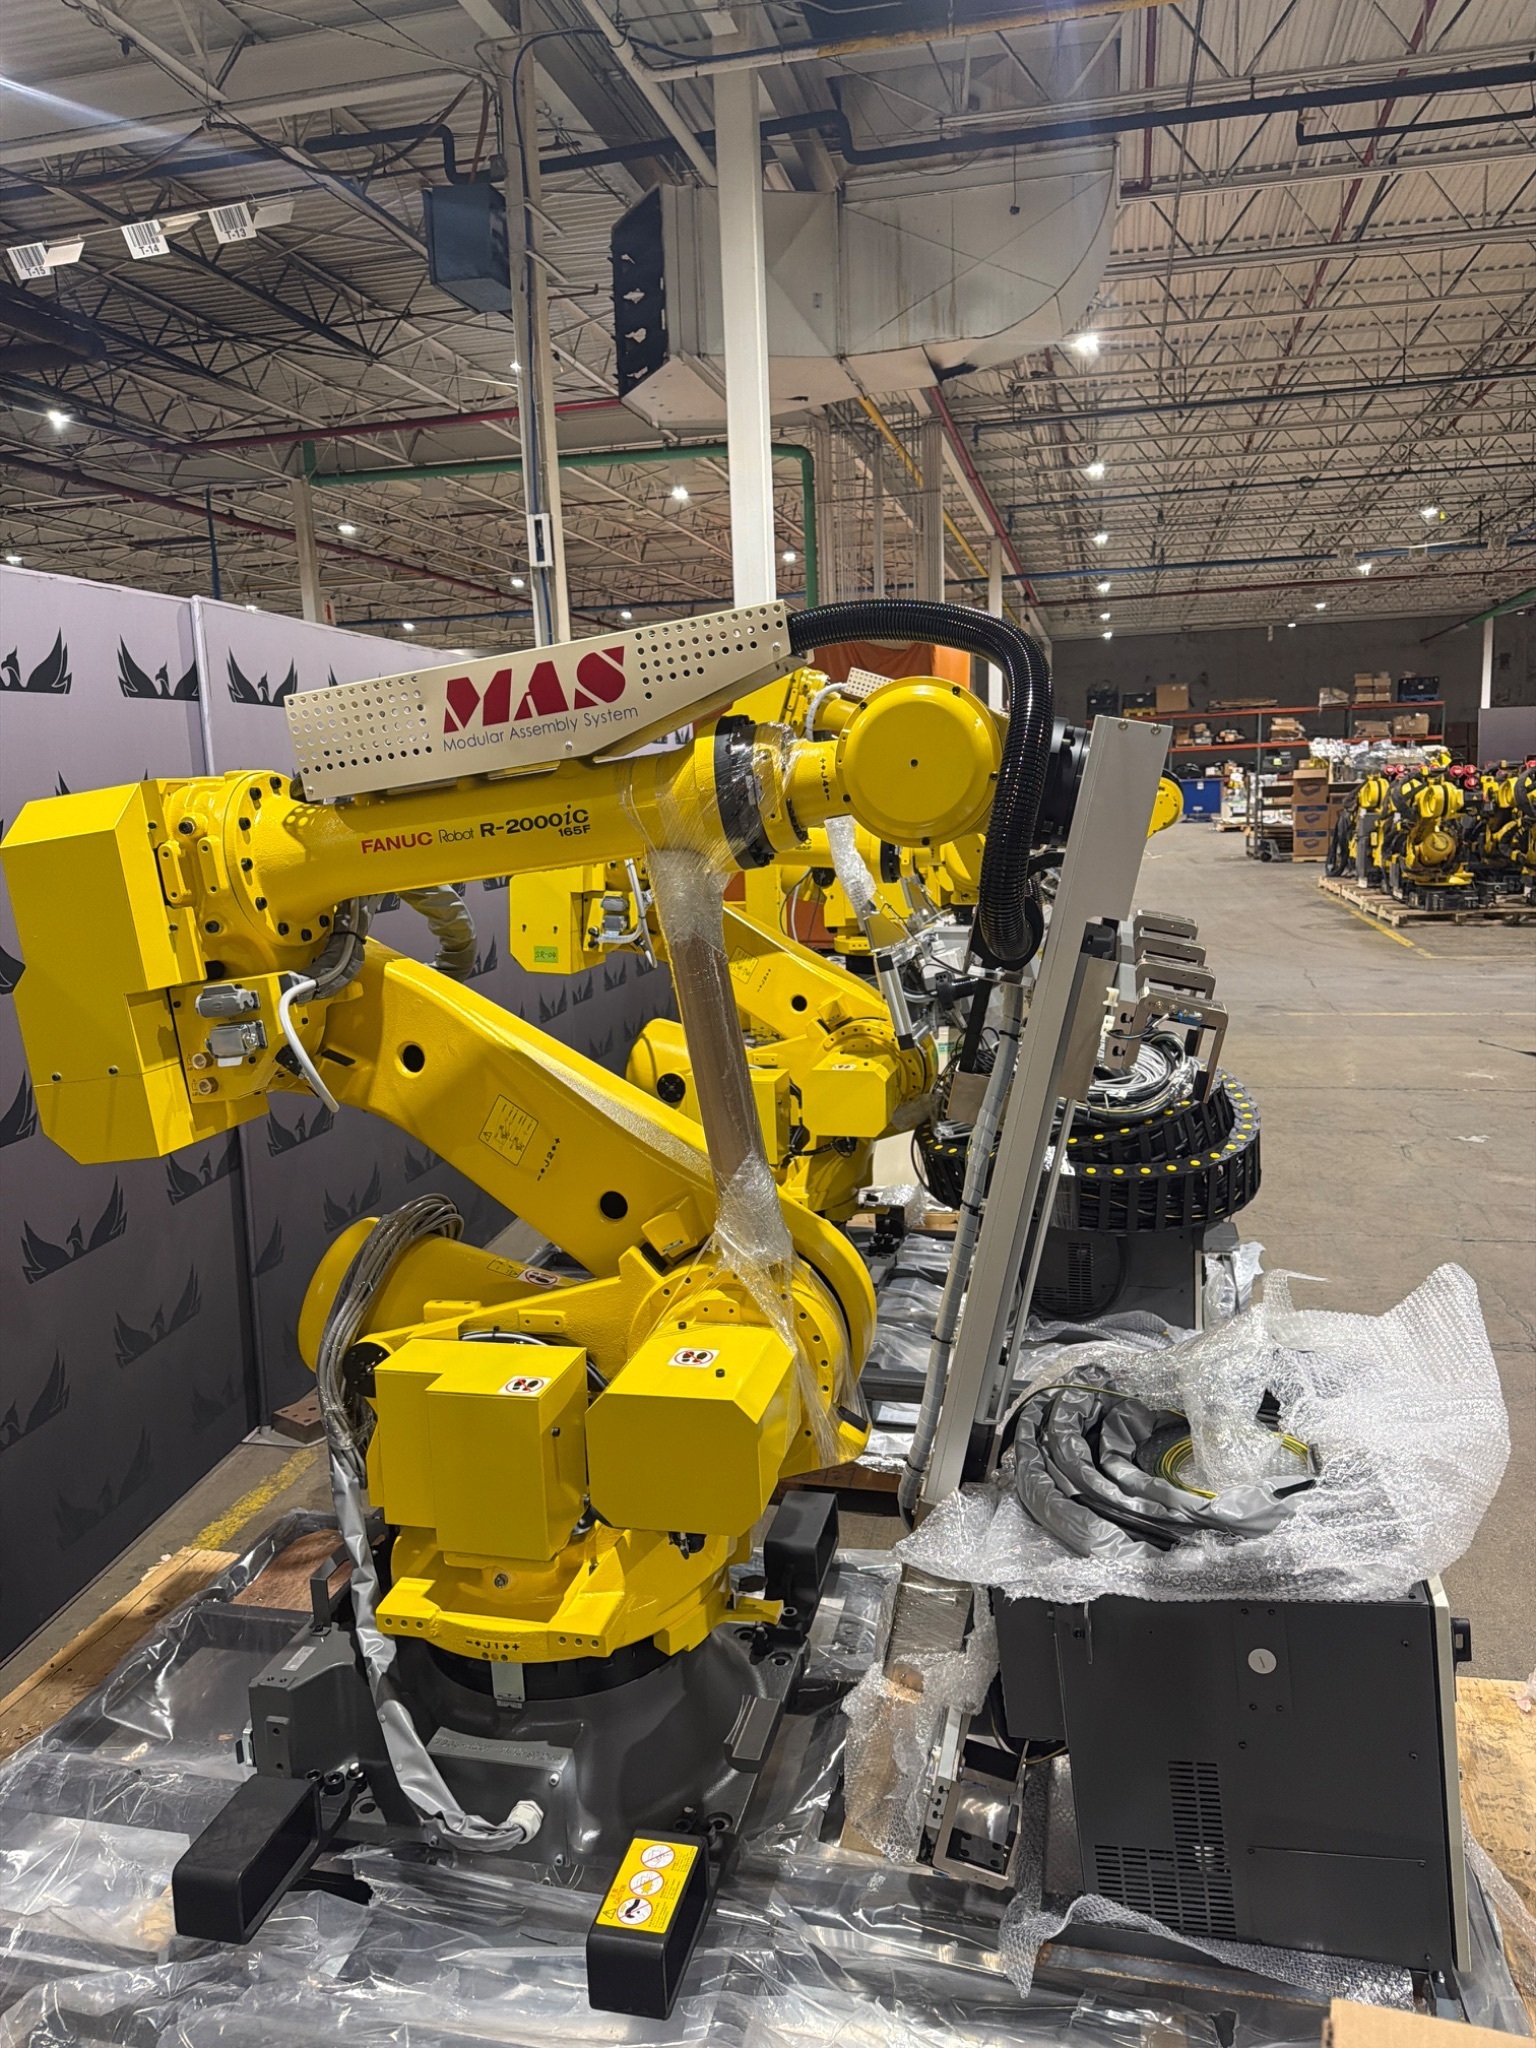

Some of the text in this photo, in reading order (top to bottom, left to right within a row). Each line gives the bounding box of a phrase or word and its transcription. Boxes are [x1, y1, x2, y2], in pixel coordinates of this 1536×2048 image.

[225, 228, 247, 239] T-13
[138, 244, 160, 255] T-14
[25, 267, 46, 277] T-15
[443, 645, 626, 734] MAS
[443, 706, 639, 752] Modular Assembly System
[360, 804, 589, 854] FANUC Robot R-2000iC
[558, 824, 591, 838] 165F
